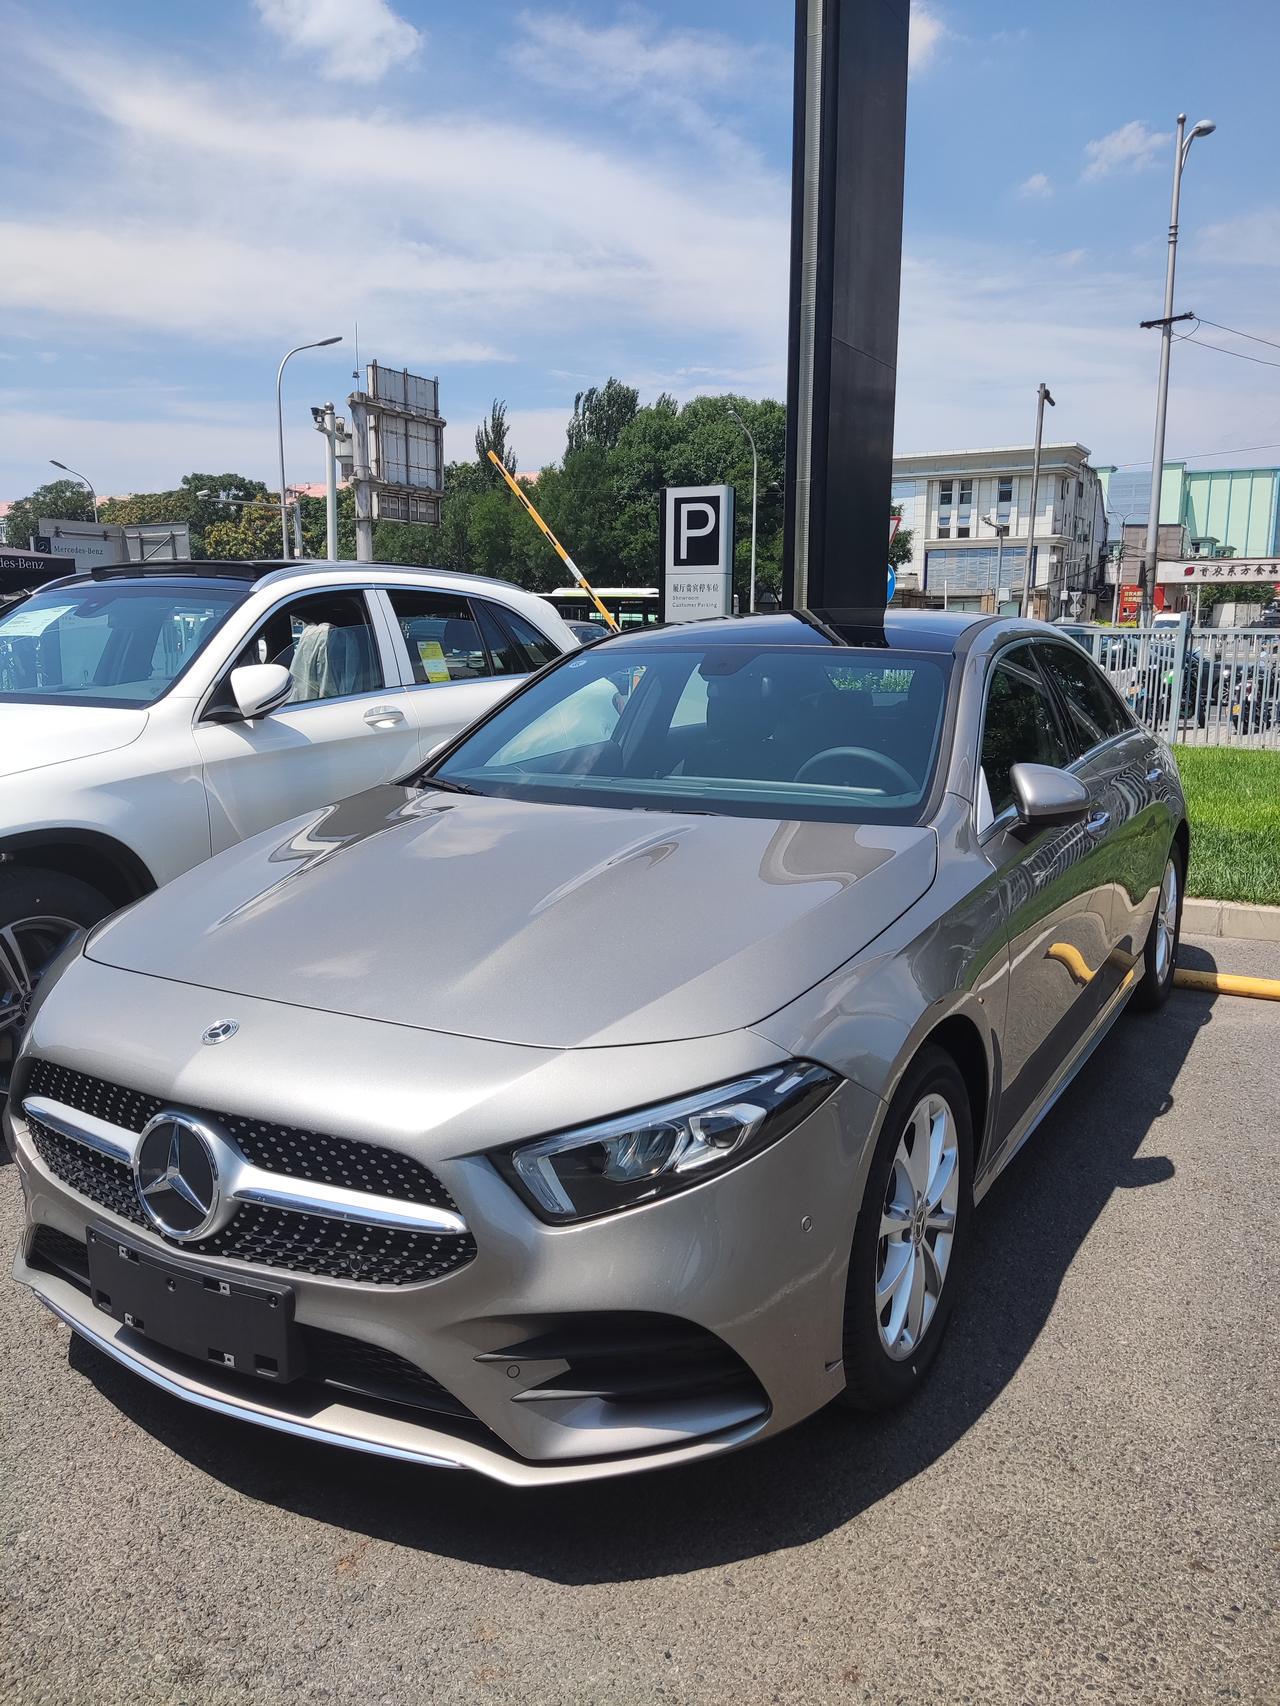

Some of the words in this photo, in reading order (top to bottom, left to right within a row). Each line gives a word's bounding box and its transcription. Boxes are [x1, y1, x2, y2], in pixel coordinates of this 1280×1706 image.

[680, 502, 716, 560] P
[54, 545, 104, 555] Mercedes-Benz
[672, 583, 719, 593] 展厅贵宾停车位
